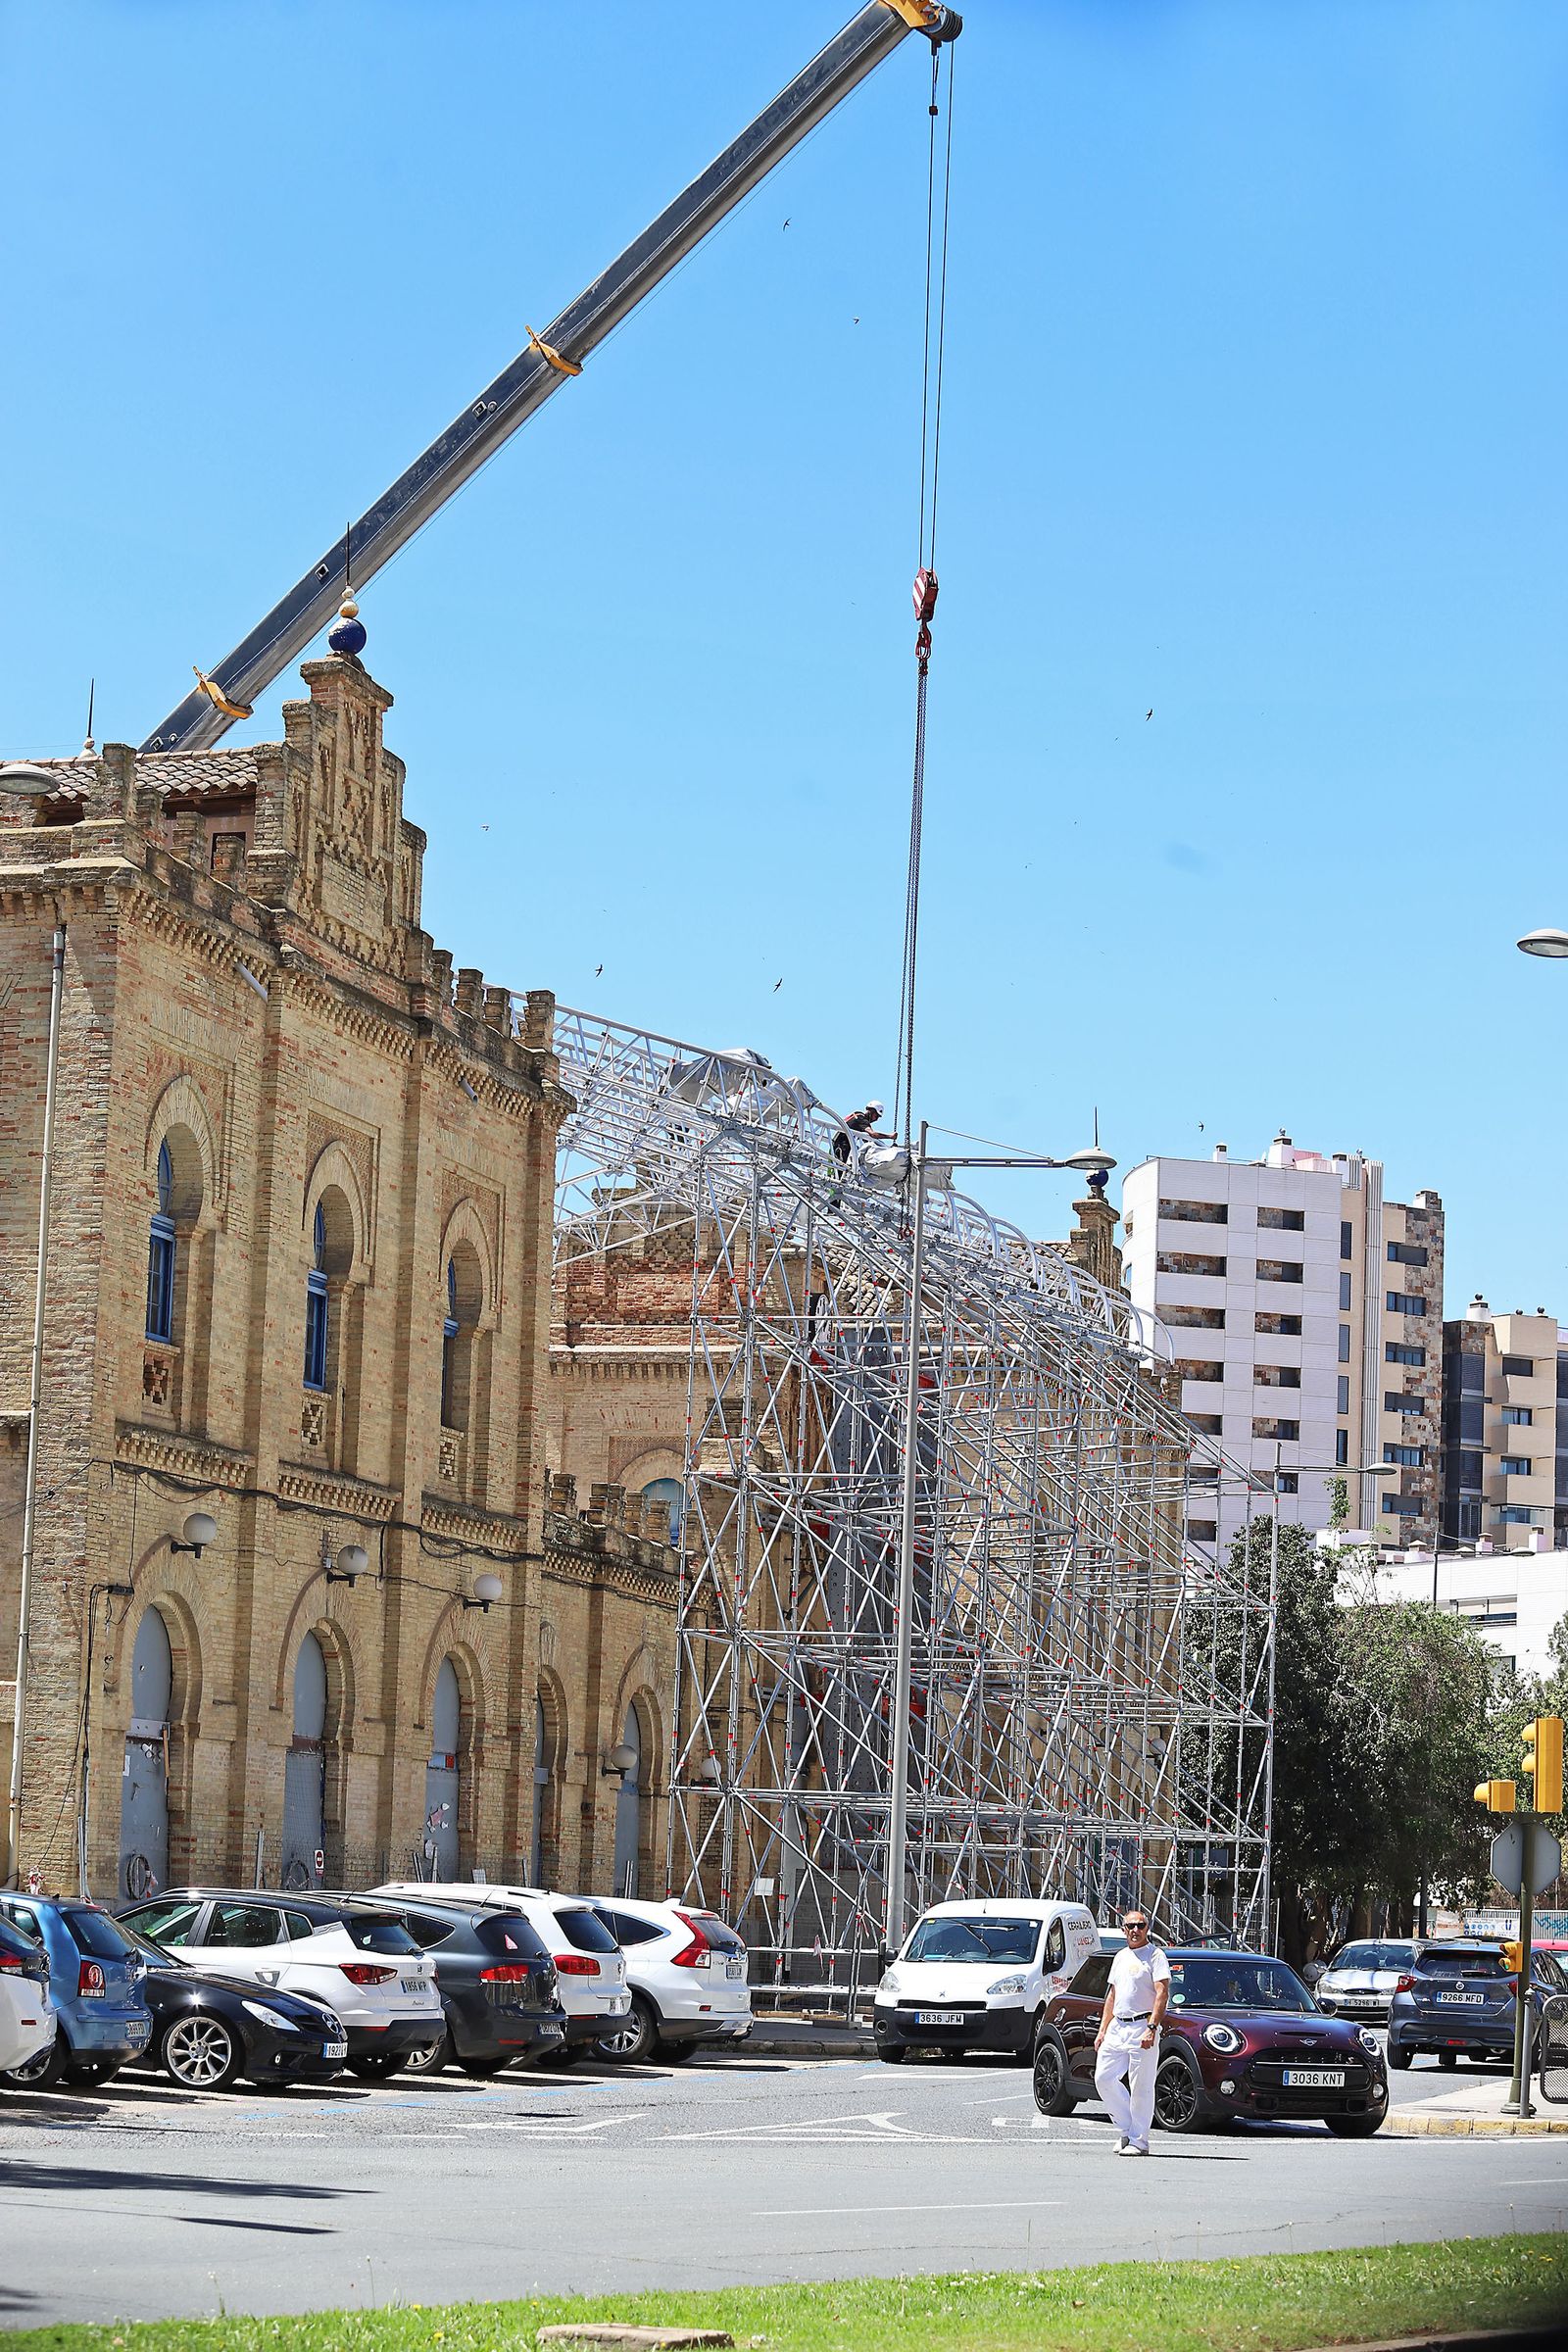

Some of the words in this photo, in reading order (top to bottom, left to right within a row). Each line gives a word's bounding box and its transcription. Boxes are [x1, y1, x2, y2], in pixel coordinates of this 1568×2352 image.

[1442, 1992, 1463, 2002] 9266
[920, 2014, 943, 2023] 3636
[1292, 2073, 1319, 2084] 3036
[1322, 2073, 1344, 2084] KNT
